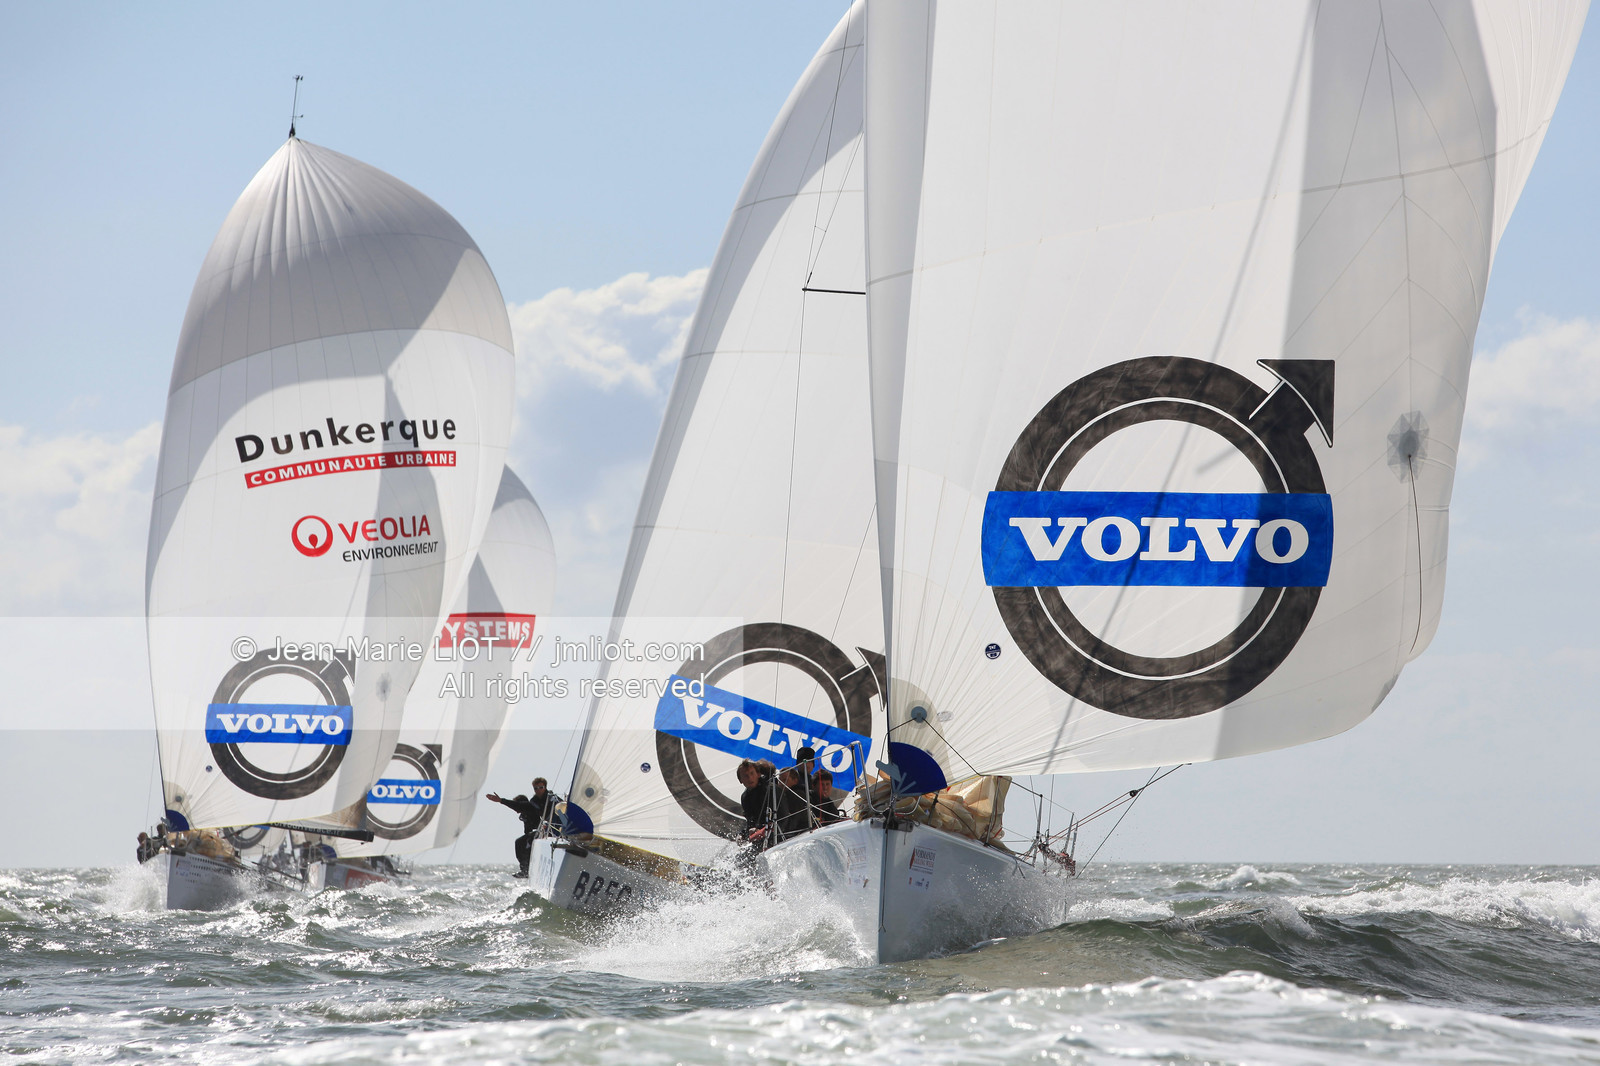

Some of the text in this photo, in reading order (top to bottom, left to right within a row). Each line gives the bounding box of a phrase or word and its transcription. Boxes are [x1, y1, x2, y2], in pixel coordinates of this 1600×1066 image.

[235, 418, 456, 463] Dunkerque
[250, 453, 455, 485] COMMUNAUTE URBAINE
[338, 515, 431, 544] VEOLIA
[1009, 516, 1309, 564] VOLVO
[342, 541, 438, 562] ENVIRONNEMENT
[439, 620, 531, 641] YSTEMS
[216, 713, 344, 735] VOLVO
[679, 694, 853, 773] VOLVO
[371, 784, 435, 799] OLVO
